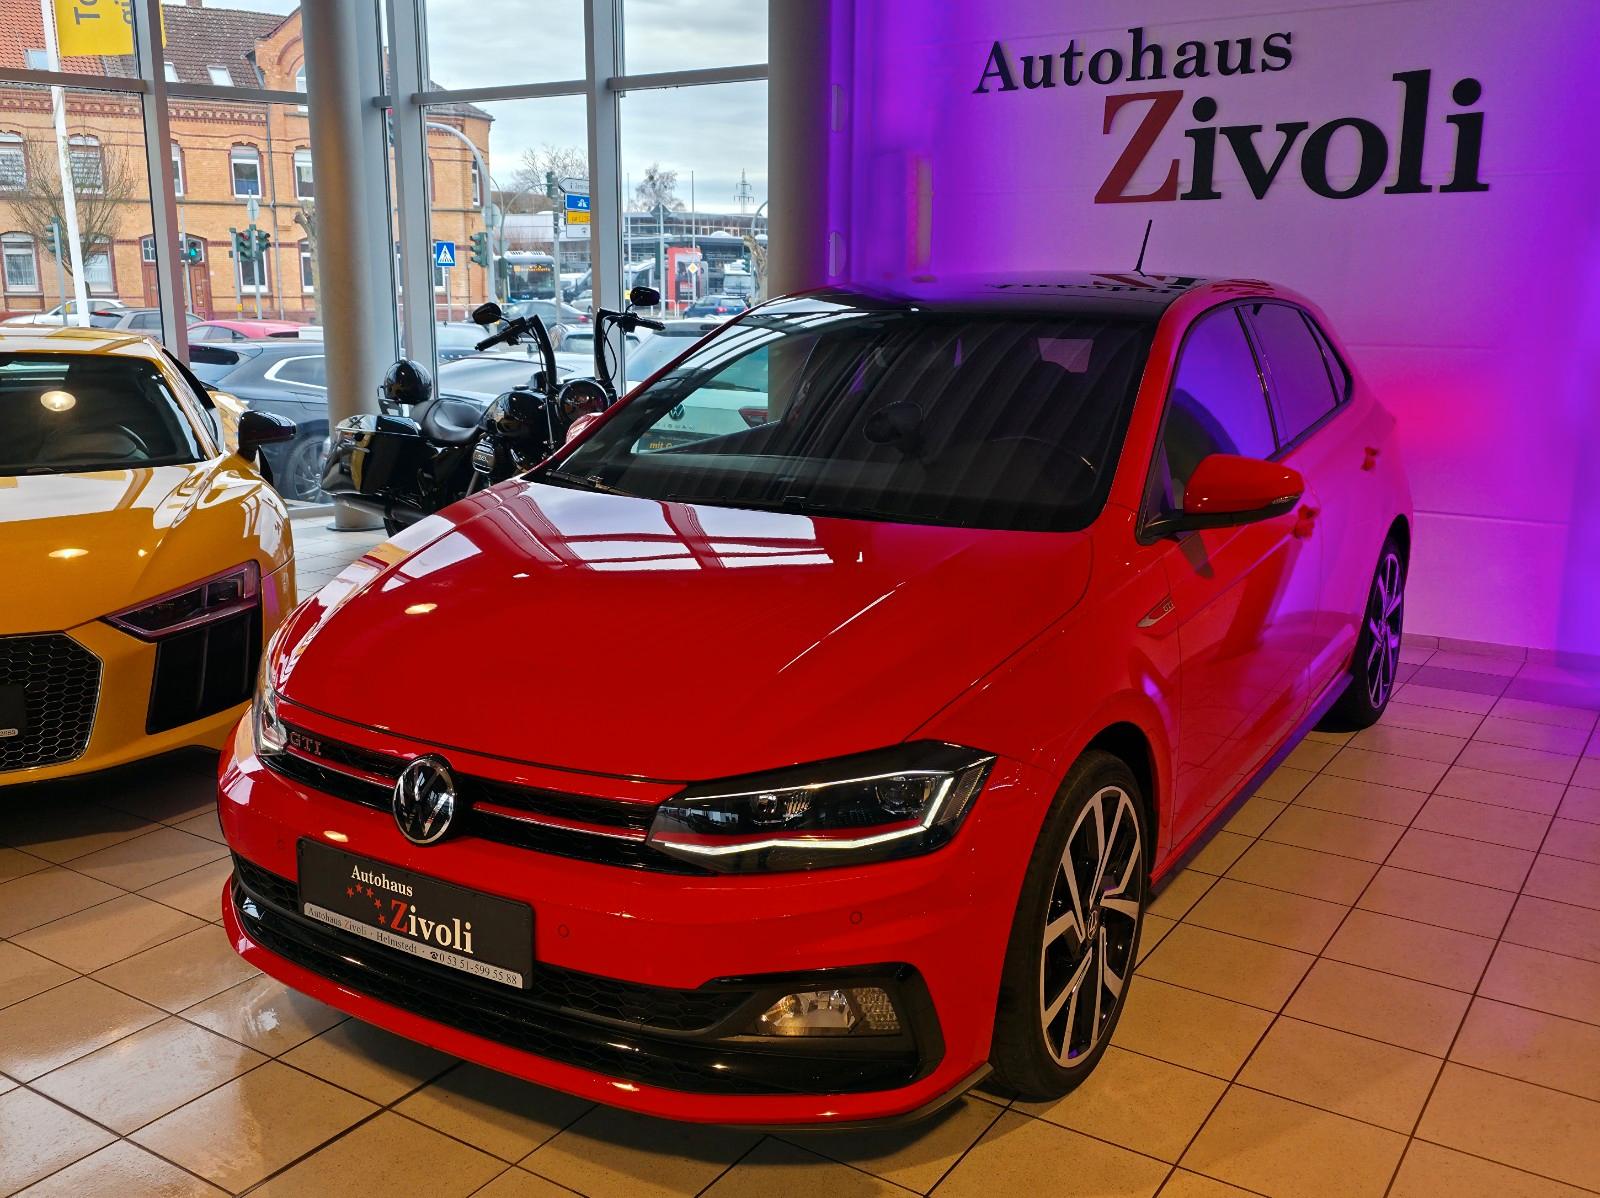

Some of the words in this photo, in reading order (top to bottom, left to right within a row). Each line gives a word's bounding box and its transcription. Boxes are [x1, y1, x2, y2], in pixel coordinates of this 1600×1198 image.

[973, 27, 1293, 95] Autohaus
[1095, 69, 1490, 204] Zivoli
[290, 731, 321, 756] GTI
[351, 865, 413, 897] Autohaus
[308, 907, 341, 926] Autohaus
[343, 919, 367, 937] Zivoli
[376, 931, 417, 954] Helmstedt
[390, 899, 474, 954] Zivoli
